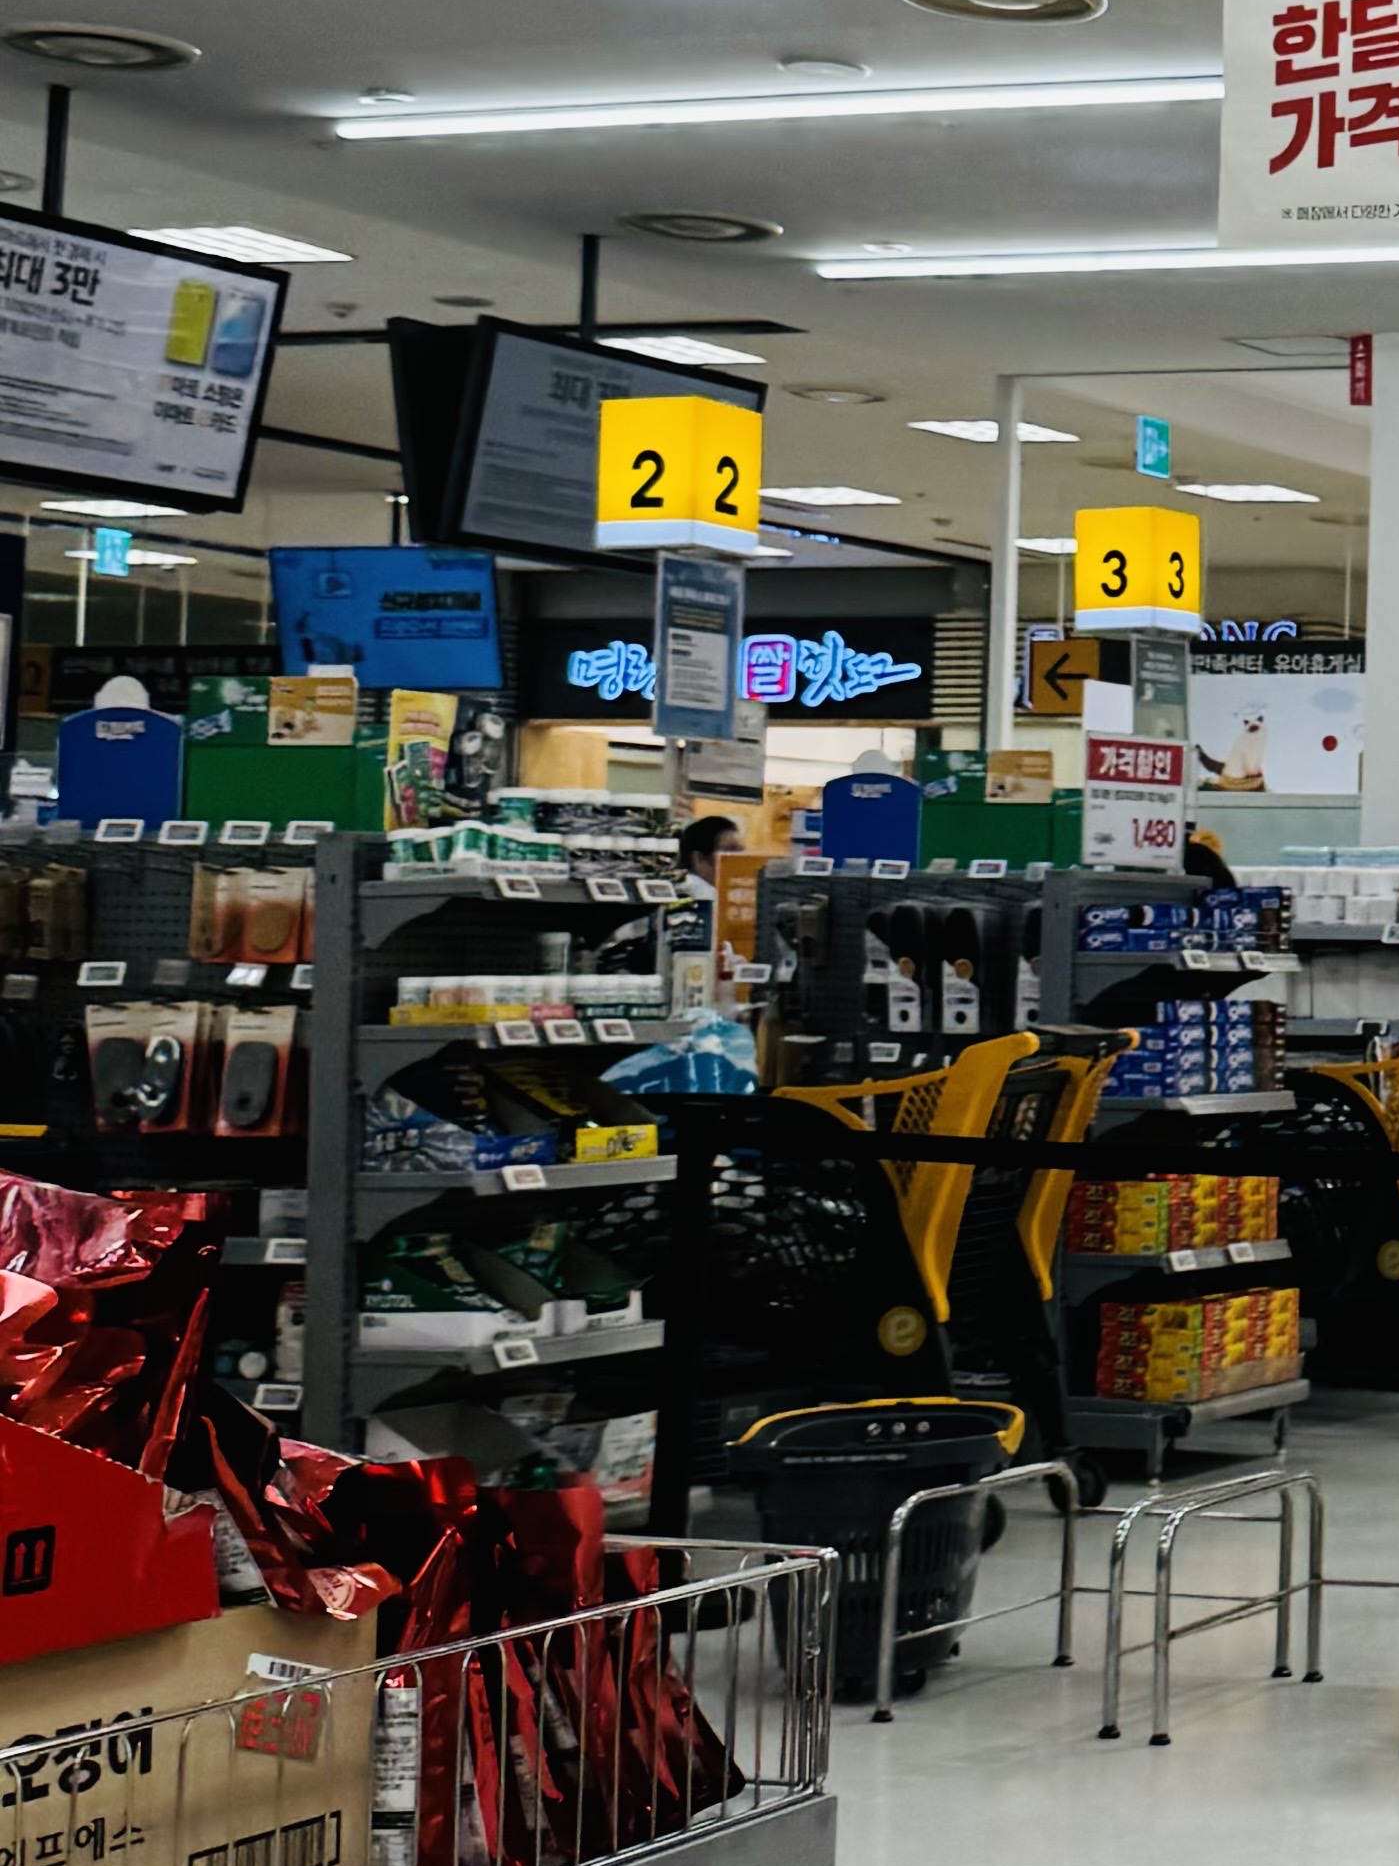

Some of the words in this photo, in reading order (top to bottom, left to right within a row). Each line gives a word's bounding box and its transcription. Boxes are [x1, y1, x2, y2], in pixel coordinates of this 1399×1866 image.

[50, 262, 101, 306] 3만
[631, 450, 665, 508] 2
[715, 456, 739, 516] 2
[1101, 550, 1127, 597] 3
[1168, 552, 1184, 599] 3
[1100, 746, 1171, 780] 가격할인
